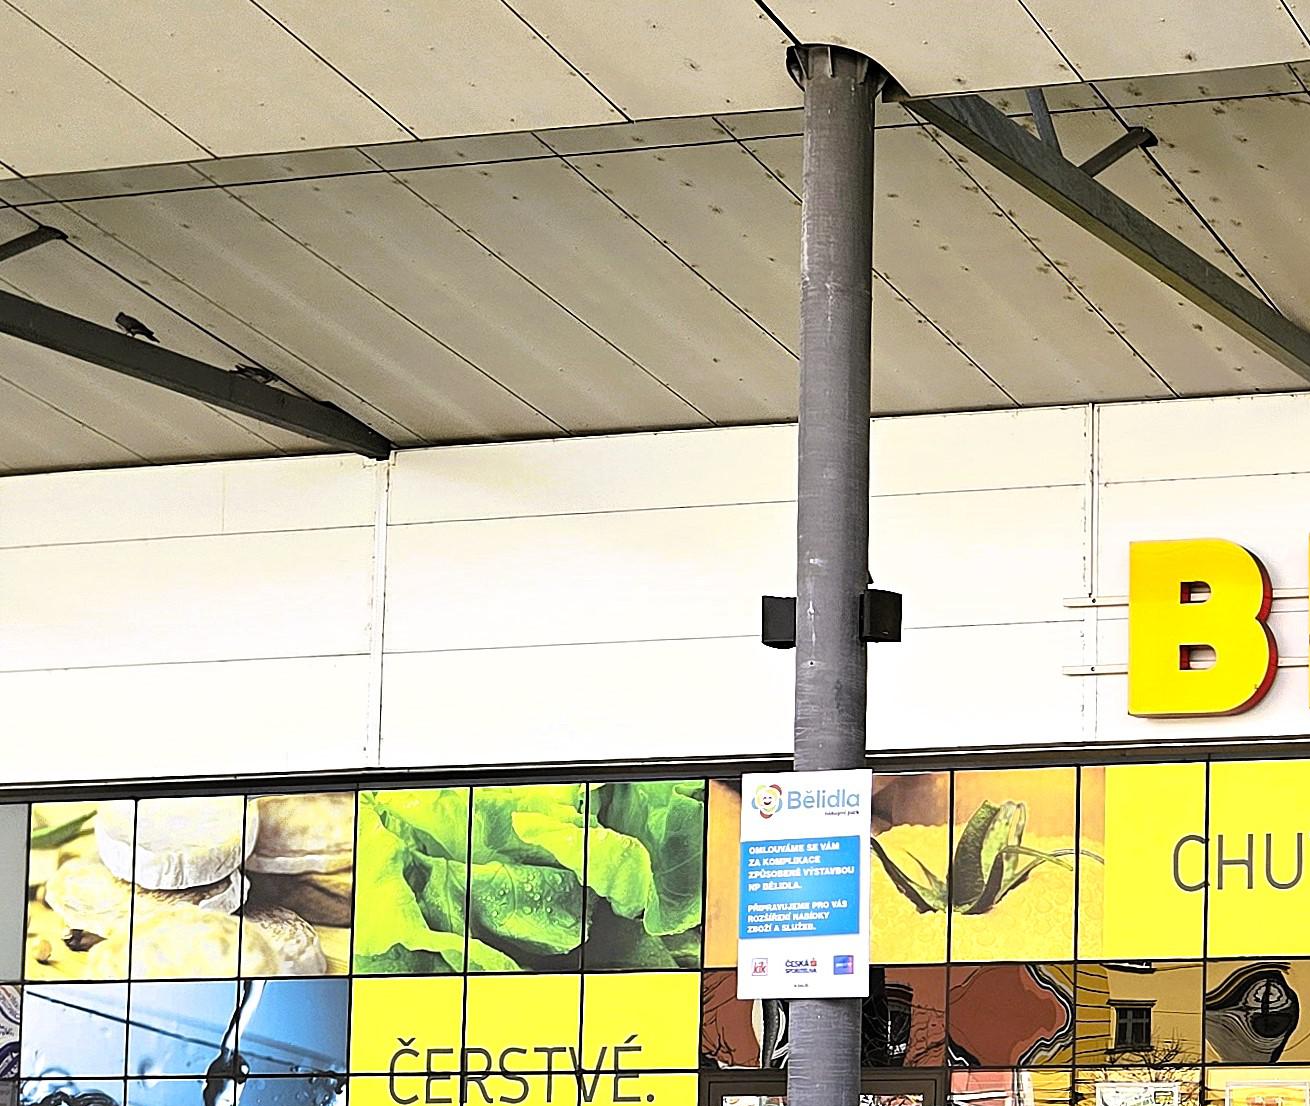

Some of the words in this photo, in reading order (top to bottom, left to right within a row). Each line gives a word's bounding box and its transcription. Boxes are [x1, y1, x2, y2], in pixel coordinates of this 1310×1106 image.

[787, 789, 860, 810] Bělidla
[748, 843, 805, 855] OMLOUVÁME
[806, 844, 819, 852] SE
[820, 841, 840, 851] VÁM
[748, 858, 761, 867] ZA
[762, 855, 821, 866] KOMPLIKACE
[803, 866, 855, 876] VÝSTAVBOU
[812, 900, 830, 909] PRO
[831, 899, 848, 909] VÁS
[773, 924, 780, 932] A
[389, 1034, 655, 1105] ČERSTVÉ.
